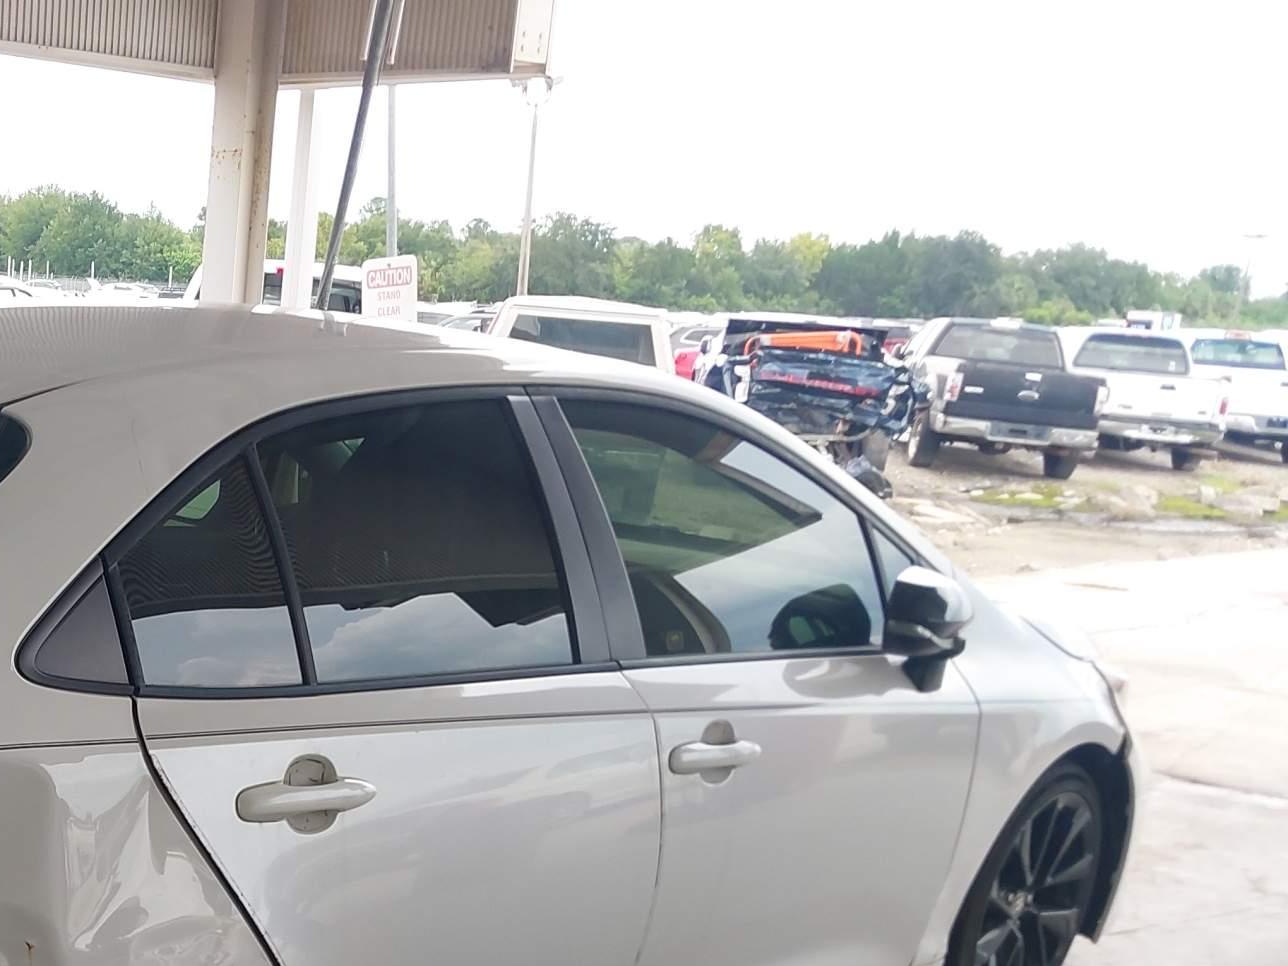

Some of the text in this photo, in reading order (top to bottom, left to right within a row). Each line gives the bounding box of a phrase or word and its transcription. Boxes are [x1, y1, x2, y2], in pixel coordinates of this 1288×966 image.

[368, 268, 411, 288] CAUTION
[377, 290, 401, 301] STAND
[377, 305, 401, 317] CLEAR
